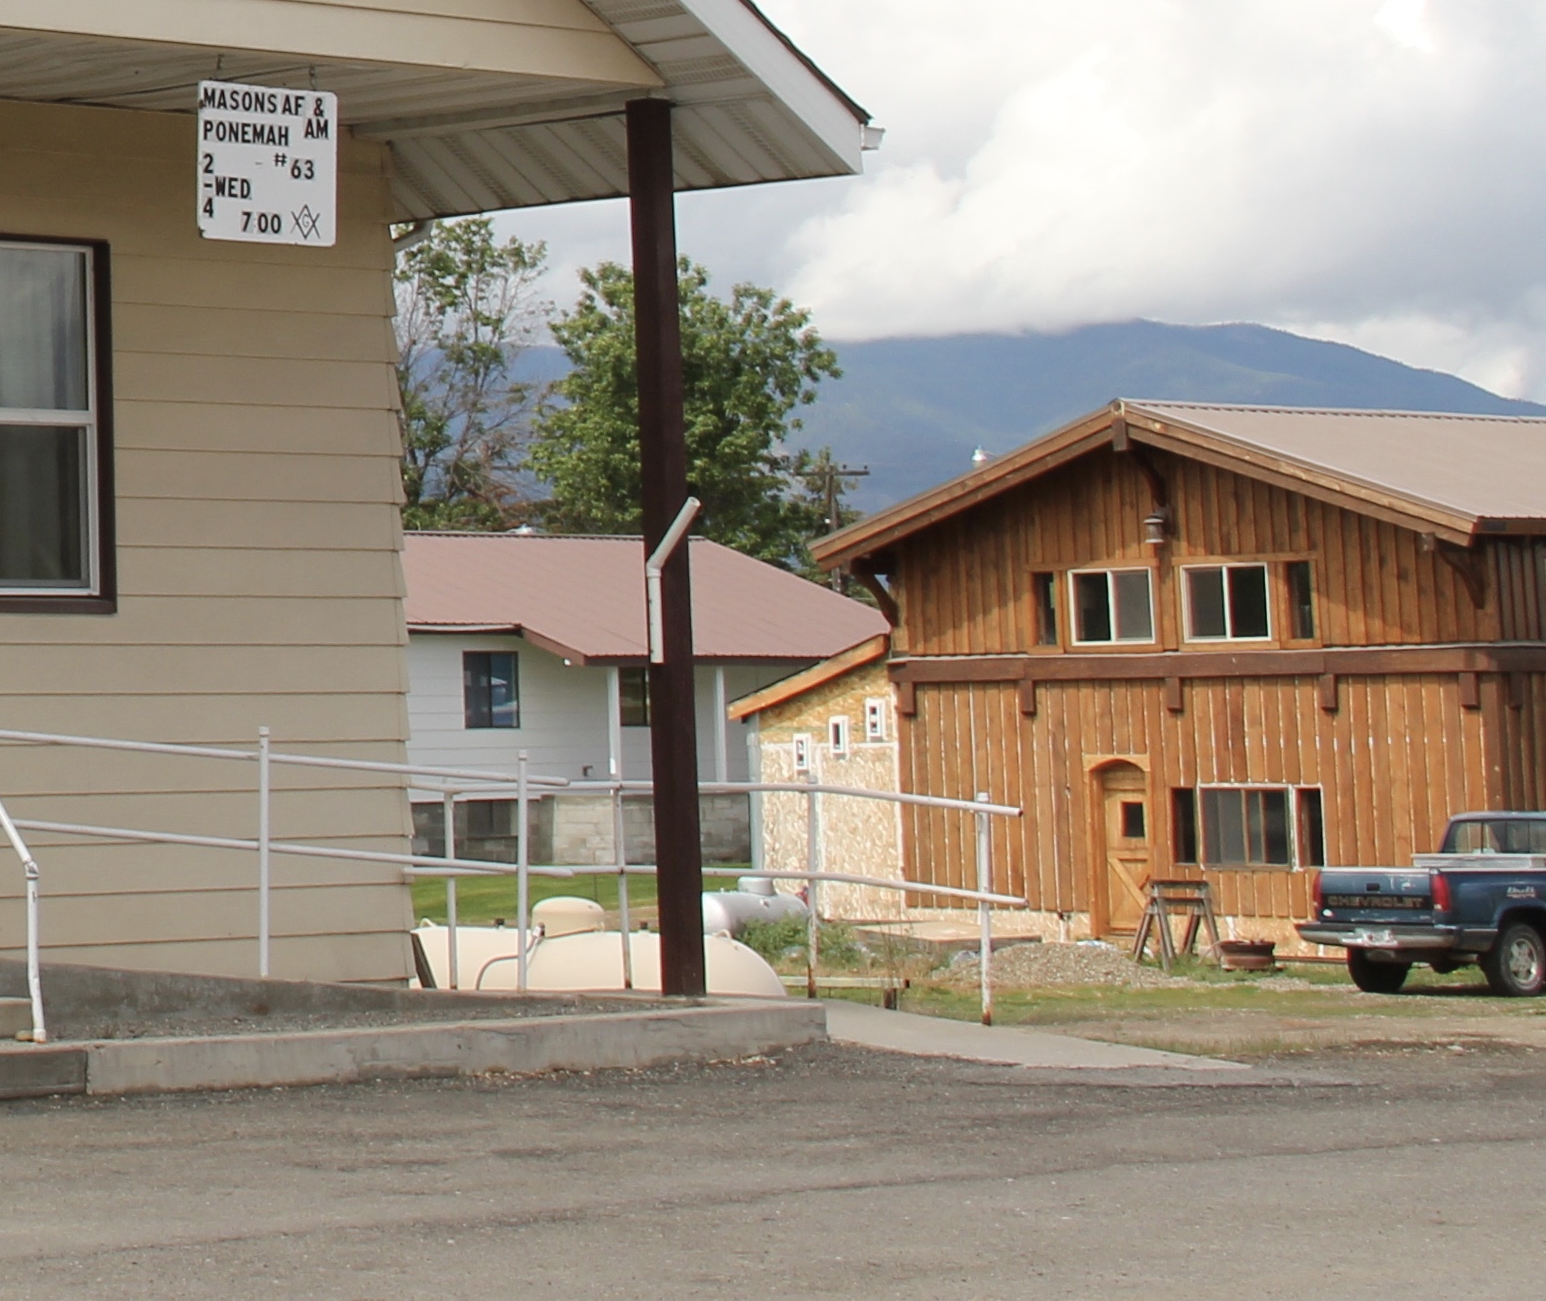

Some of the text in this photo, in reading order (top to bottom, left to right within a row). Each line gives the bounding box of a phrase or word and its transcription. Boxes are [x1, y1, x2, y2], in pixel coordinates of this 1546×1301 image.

[203, 87, 324, 118] MASONS AF &
[203, 118, 328, 146] PONEMAH AM
[203, 153, 214, 174] 2
[203, 197, 214, 218] 4
[1327, 895, 1424, 908] CHEVROLET
